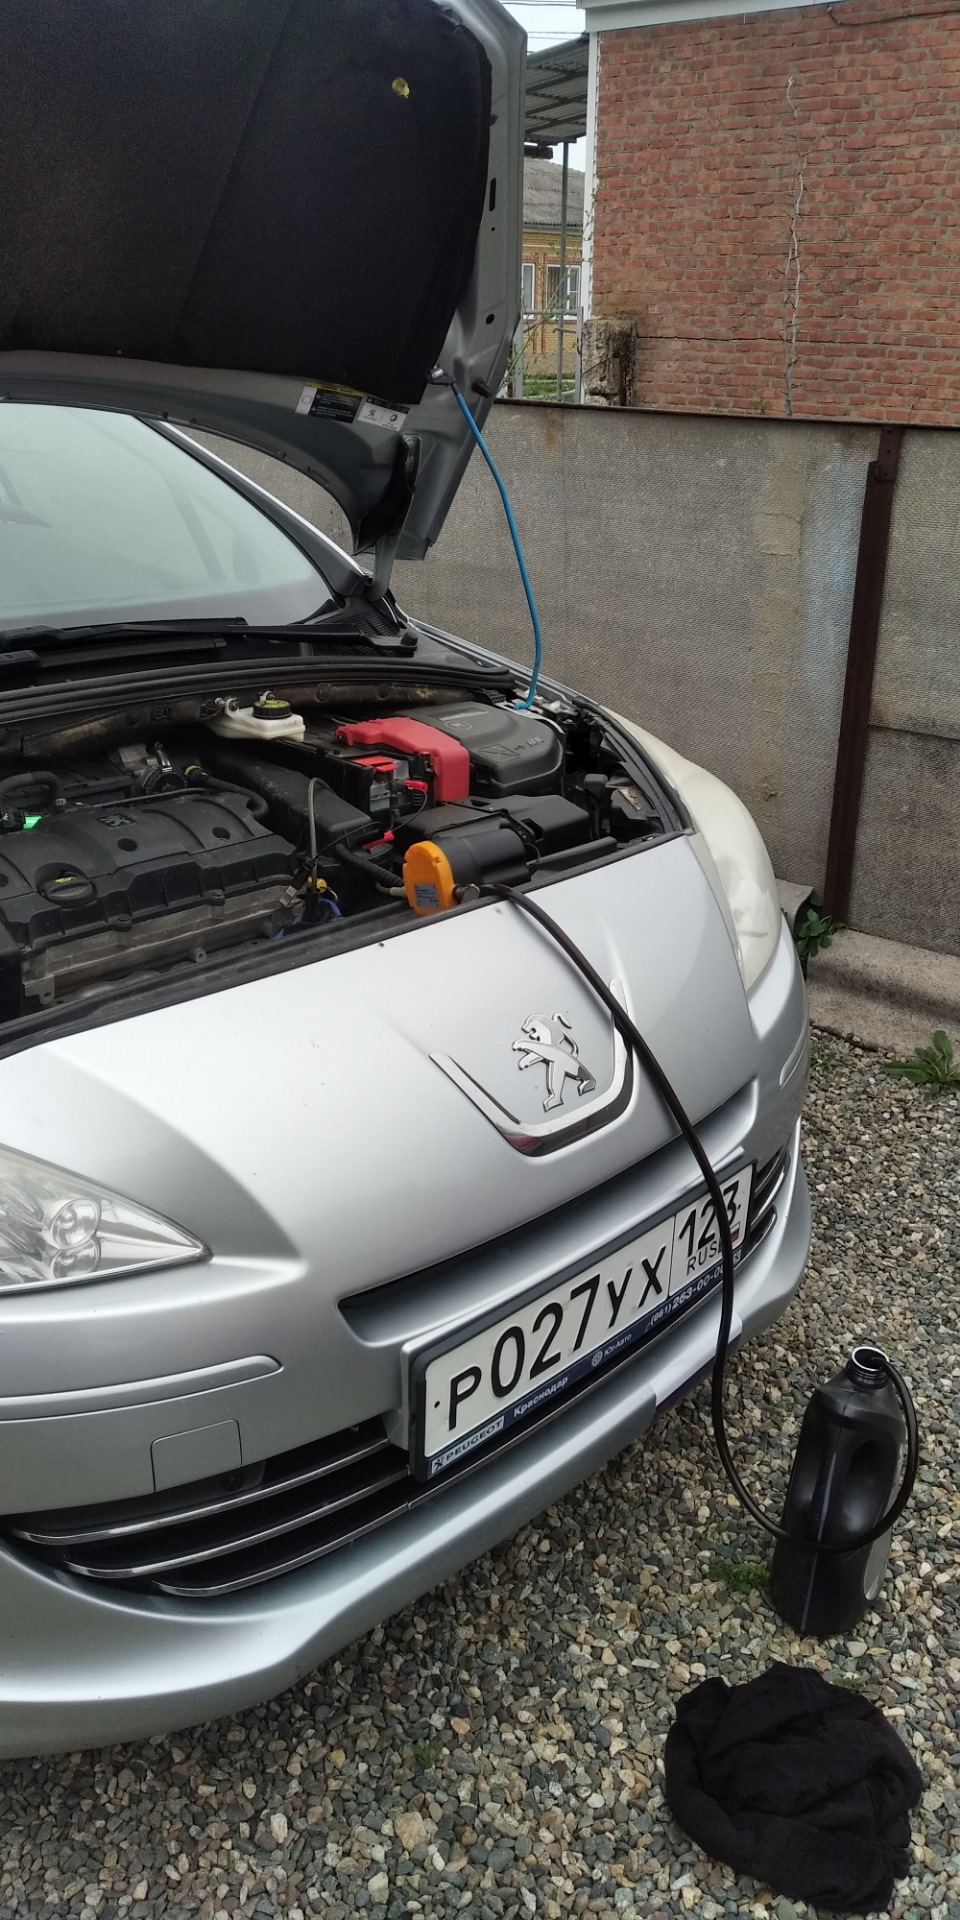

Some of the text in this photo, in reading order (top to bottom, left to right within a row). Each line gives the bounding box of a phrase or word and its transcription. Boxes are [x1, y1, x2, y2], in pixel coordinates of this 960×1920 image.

[678, 1180, 739, 1258] 123
[686, 1240, 718, 1275] RUS
[513, 1376, 568, 1417] Краснодар
[446, 1419, 503, 1461] PEUGEOT
